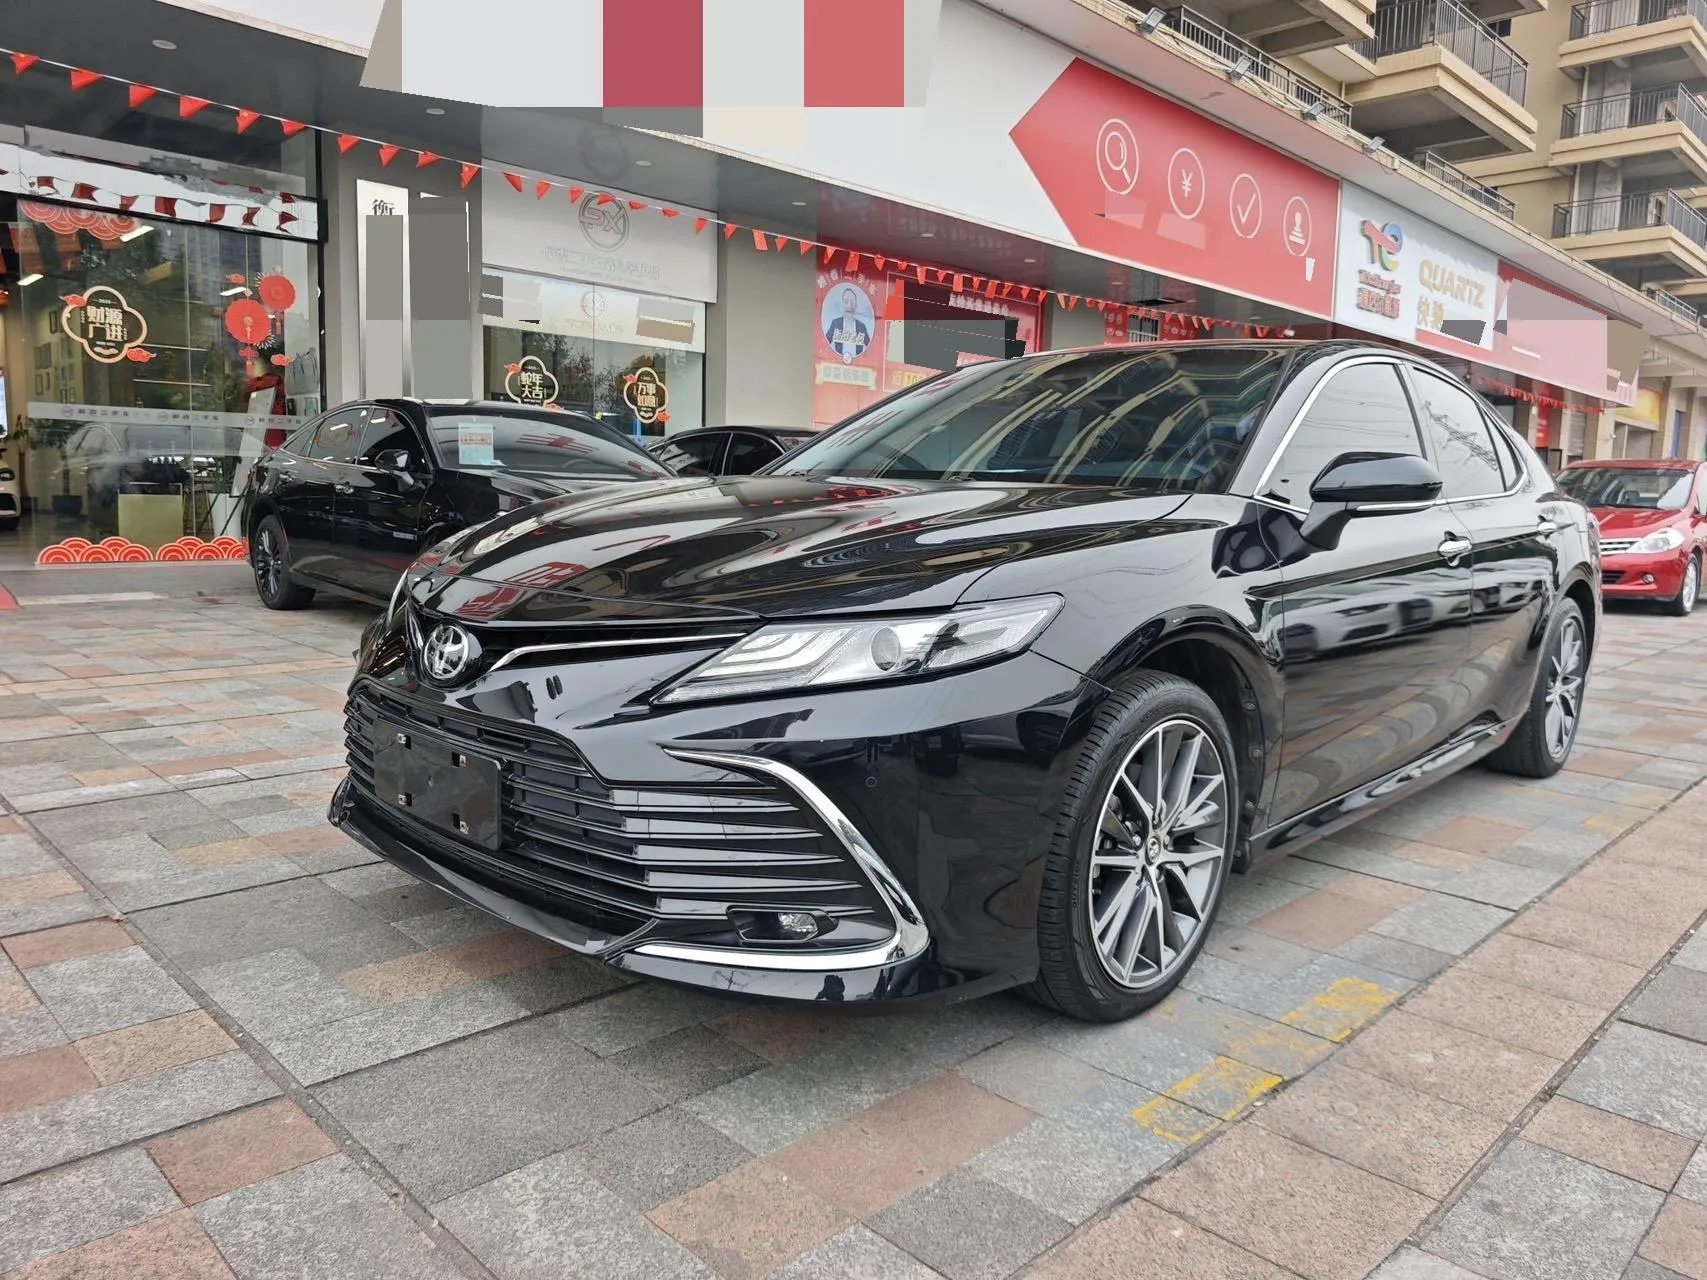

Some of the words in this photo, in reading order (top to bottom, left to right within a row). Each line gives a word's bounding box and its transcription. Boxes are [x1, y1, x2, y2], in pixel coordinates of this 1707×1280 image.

[1419, 259, 1487, 309] QUARTZ
[87, 305, 122, 326] 财源
[88, 323, 123, 341] 广进
[520, 371, 543, 386] 蛇年
[521, 385, 543, 399] 大吉
[637, 382, 656, 395] 万事
